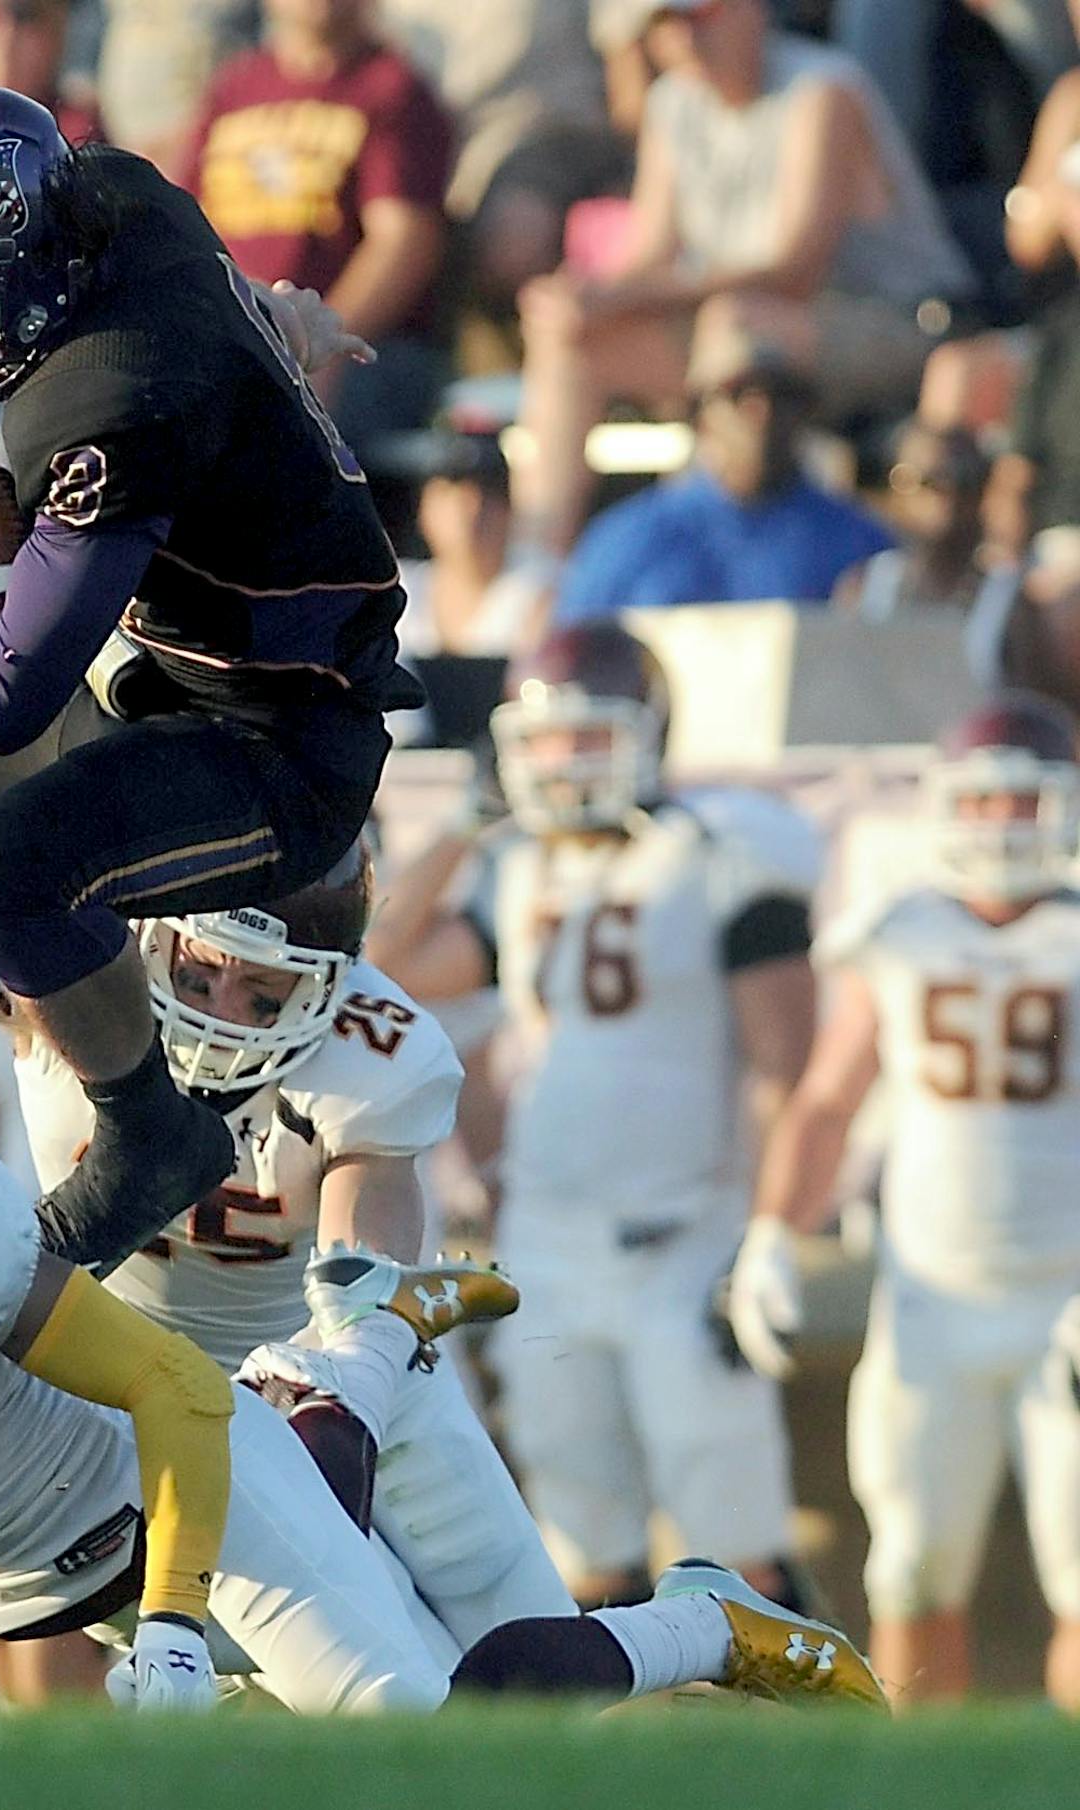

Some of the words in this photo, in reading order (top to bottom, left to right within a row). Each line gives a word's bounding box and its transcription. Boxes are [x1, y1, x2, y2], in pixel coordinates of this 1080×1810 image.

[45, 444, 107, 527] 8
[227, 908, 270, 932] DOGS
[332, 990, 417, 1061] 25
[920, 979, 1066, 1103] 59
